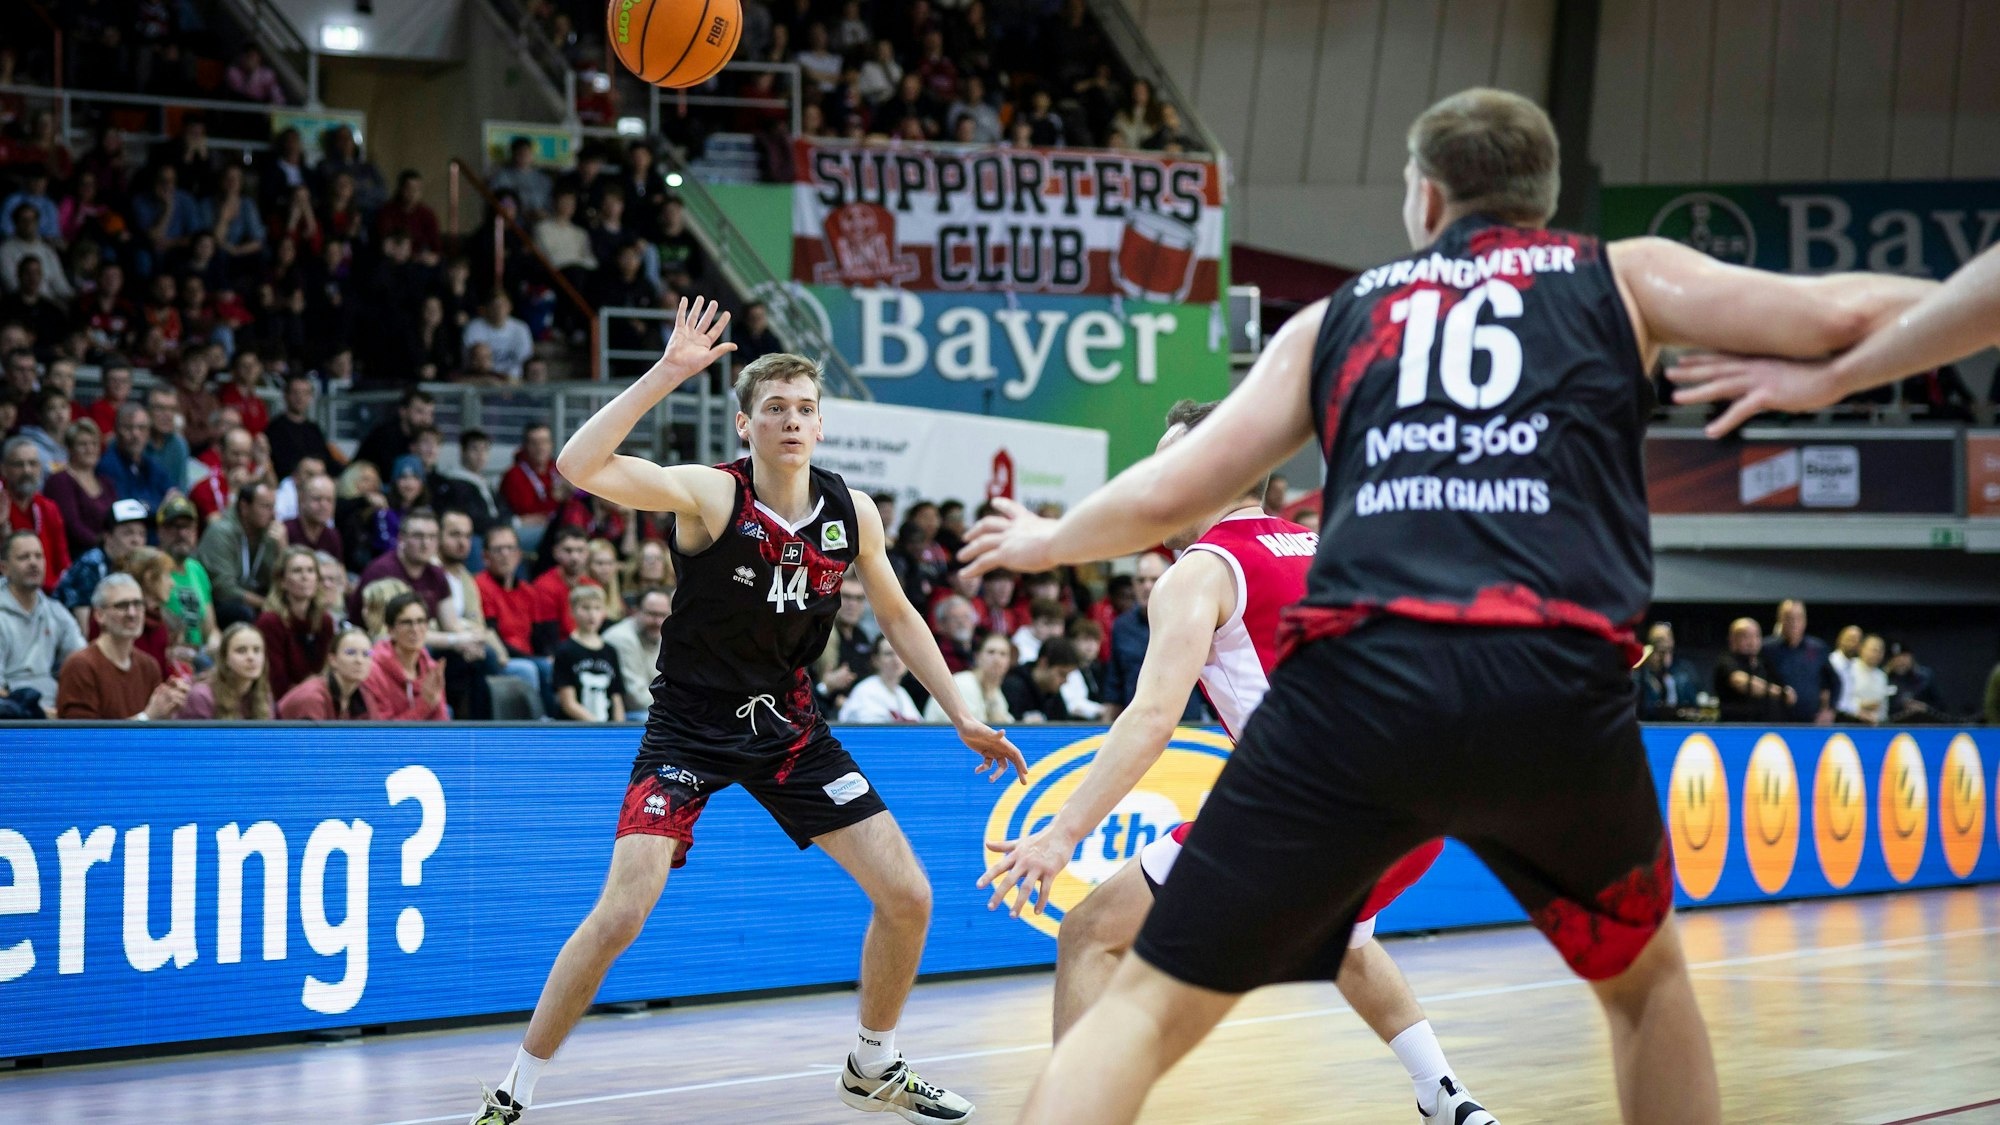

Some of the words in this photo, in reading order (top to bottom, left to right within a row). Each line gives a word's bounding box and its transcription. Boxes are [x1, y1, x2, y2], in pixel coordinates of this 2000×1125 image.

[706, 16, 725, 46] FIBA
[815, 151, 1201, 224] SUPPORTERS
[937, 225, 1084, 286] CLUB
[1353, 245, 1576, 297] STRANGMEYER
[852, 286, 1178, 400] Bayer
[1390, 279, 1524, 410] 16
[1366, 414, 1456, 467] Med
[1456, 412, 1550, 465] 360°
[1356, 476, 1443, 516] BAYER
[1445, 477, 1550, 515] GIANTS
[767, 566, 809, 613] 44
[0, 765, 447, 1014] erung?
